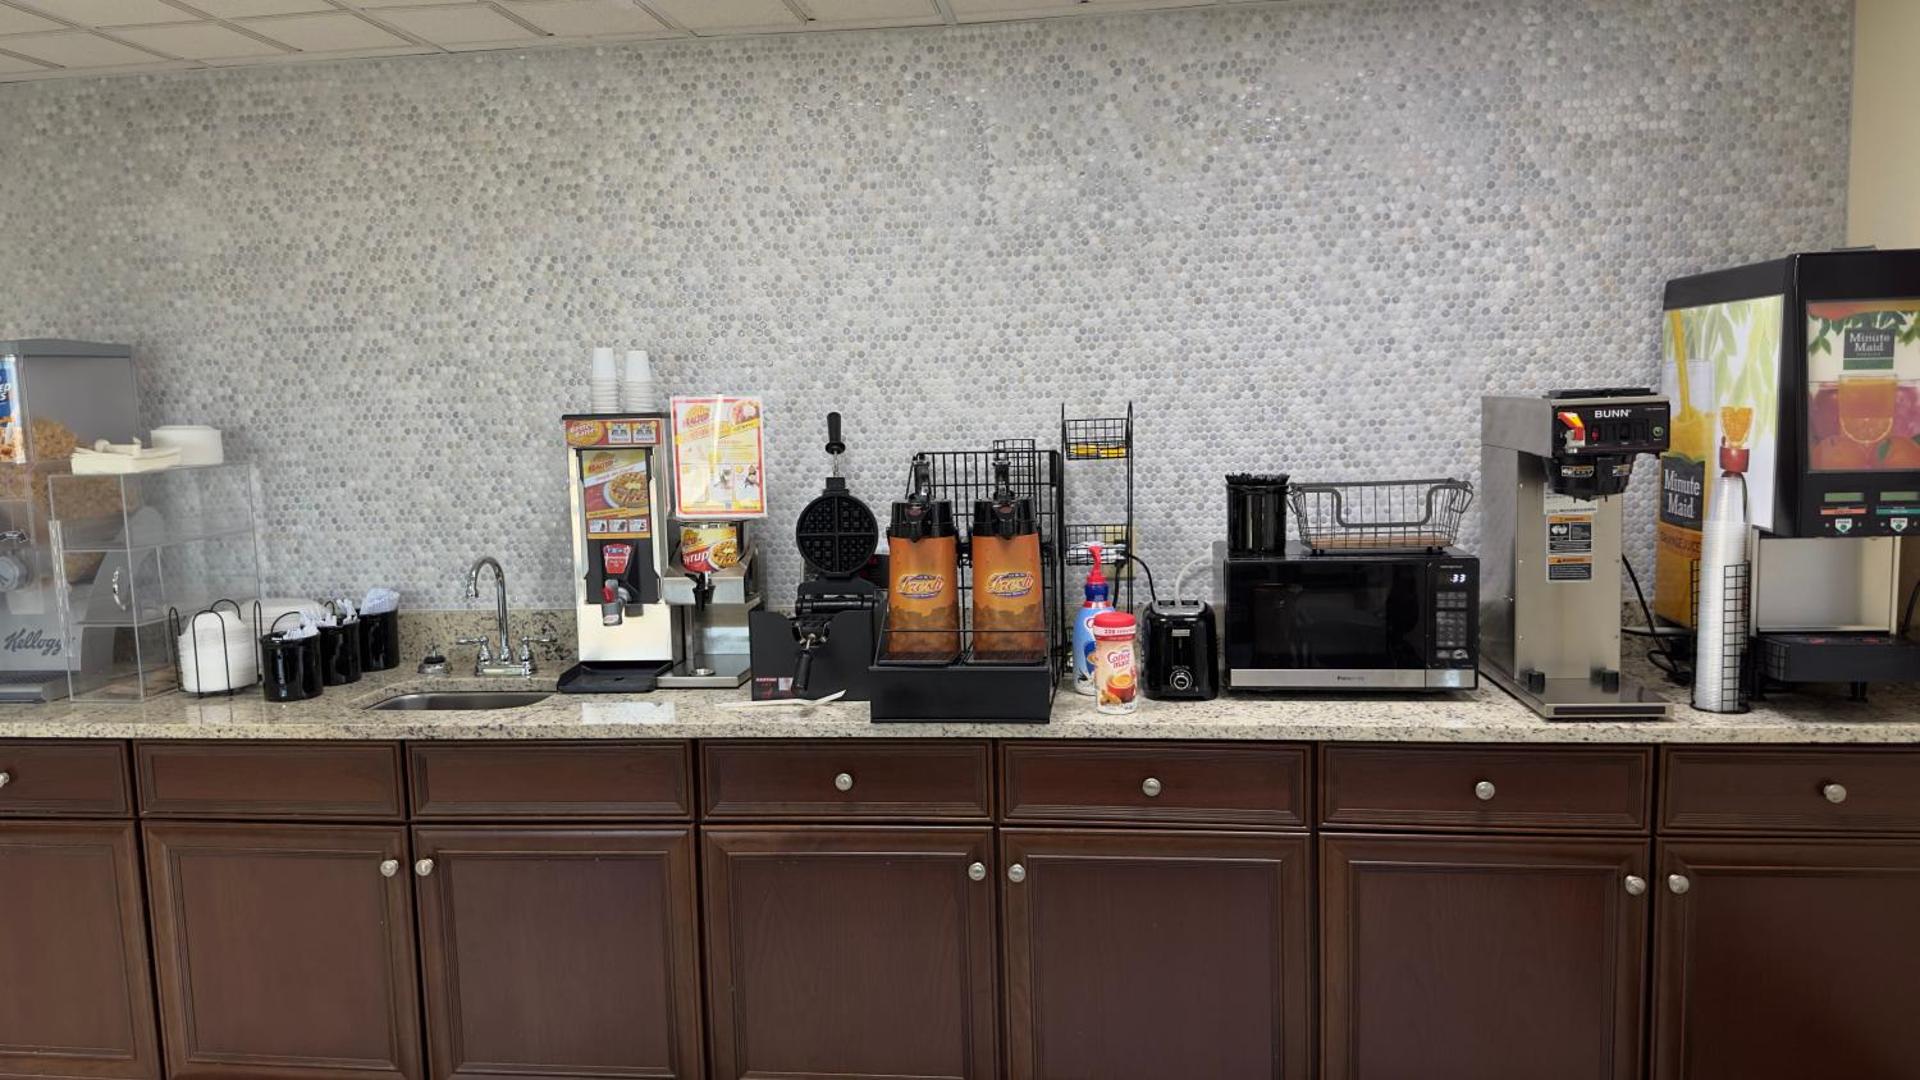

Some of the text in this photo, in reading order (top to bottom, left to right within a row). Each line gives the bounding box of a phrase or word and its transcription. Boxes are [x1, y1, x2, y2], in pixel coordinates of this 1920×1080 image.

[1849, 332, 1889, 342] Minute
[1855, 343, 1884, 352] Maid
[1595, 409, 1628, 418] BUNN
[1664, 469, 1700, 495] Minute
[1667, 493, 1694, 518] Maid
[4, 628, 75, 656] Kellogg
